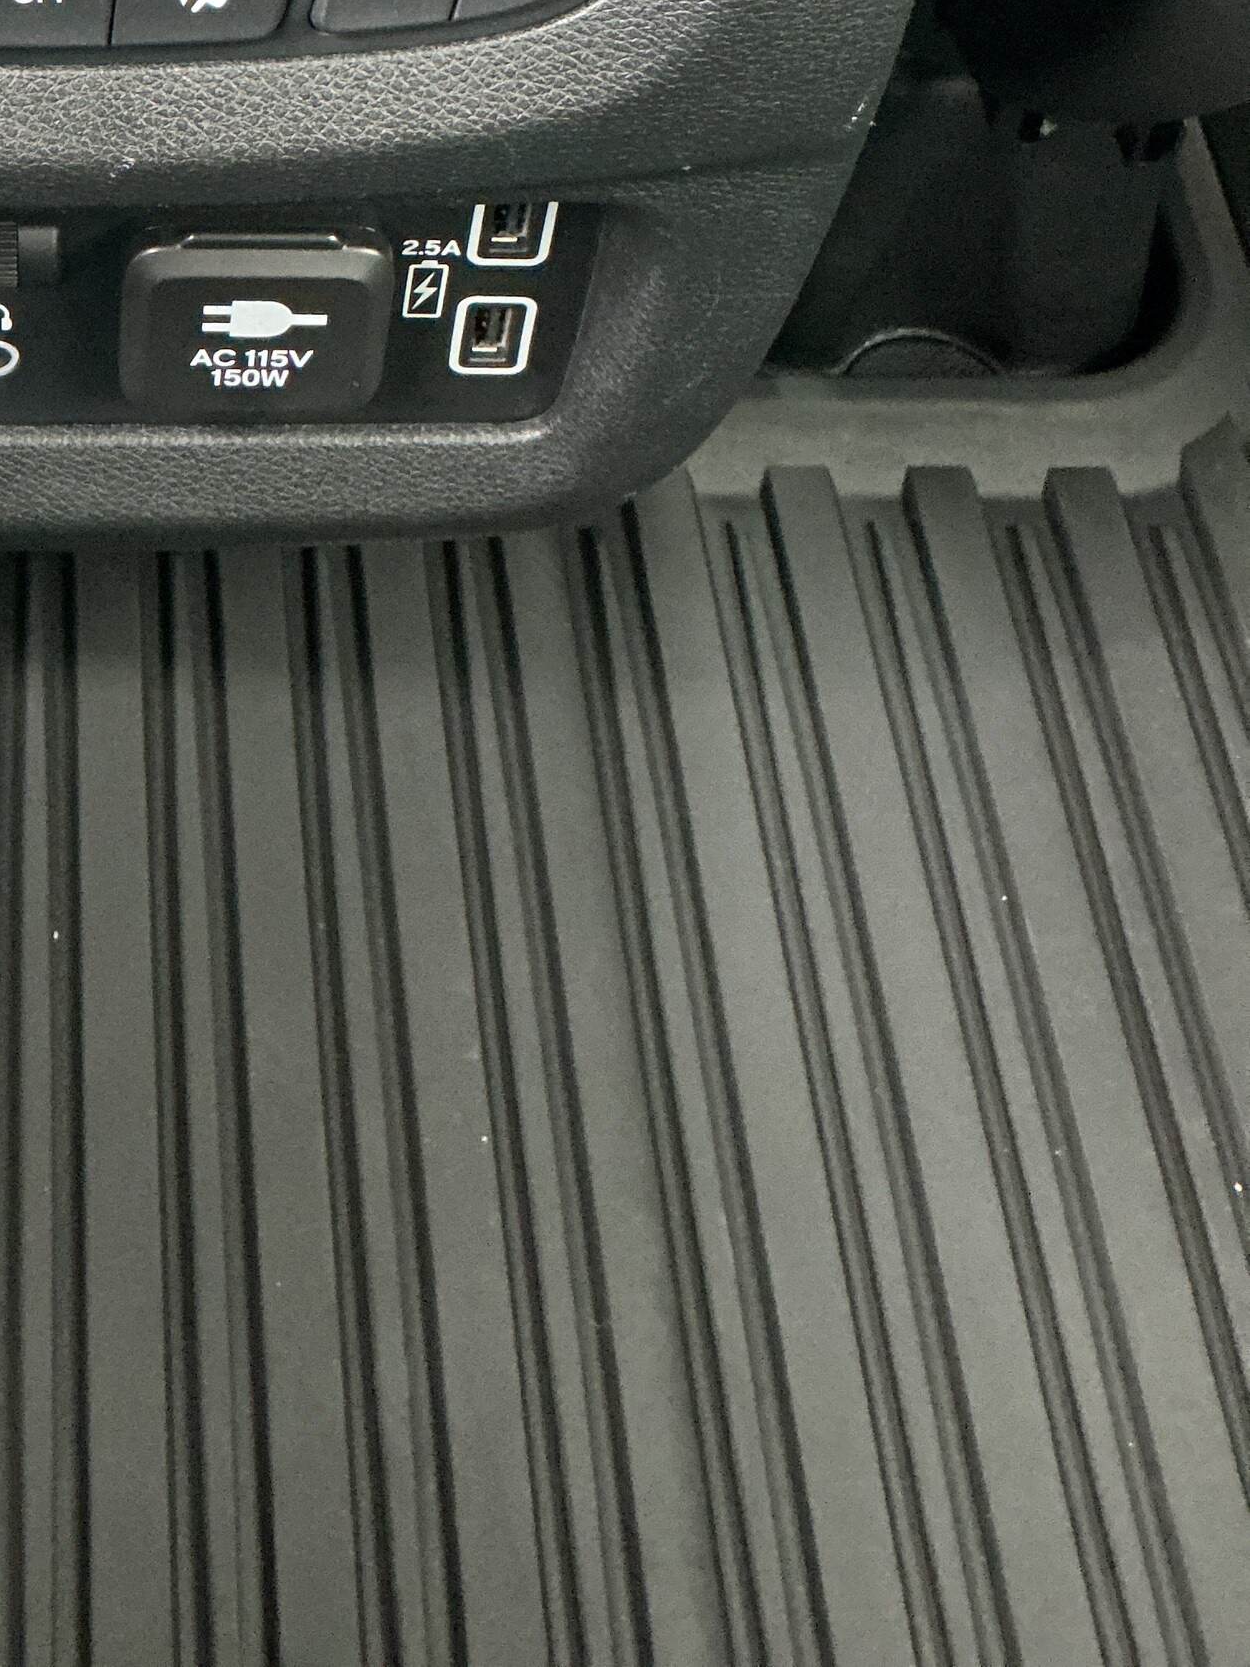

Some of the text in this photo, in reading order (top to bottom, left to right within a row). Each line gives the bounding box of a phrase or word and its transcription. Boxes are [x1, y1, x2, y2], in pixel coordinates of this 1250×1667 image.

[401, 239, 462, 257] 2.5A
[189, 348, 314, 368] AC 115V
[210, 368, 290, 388] 150W
